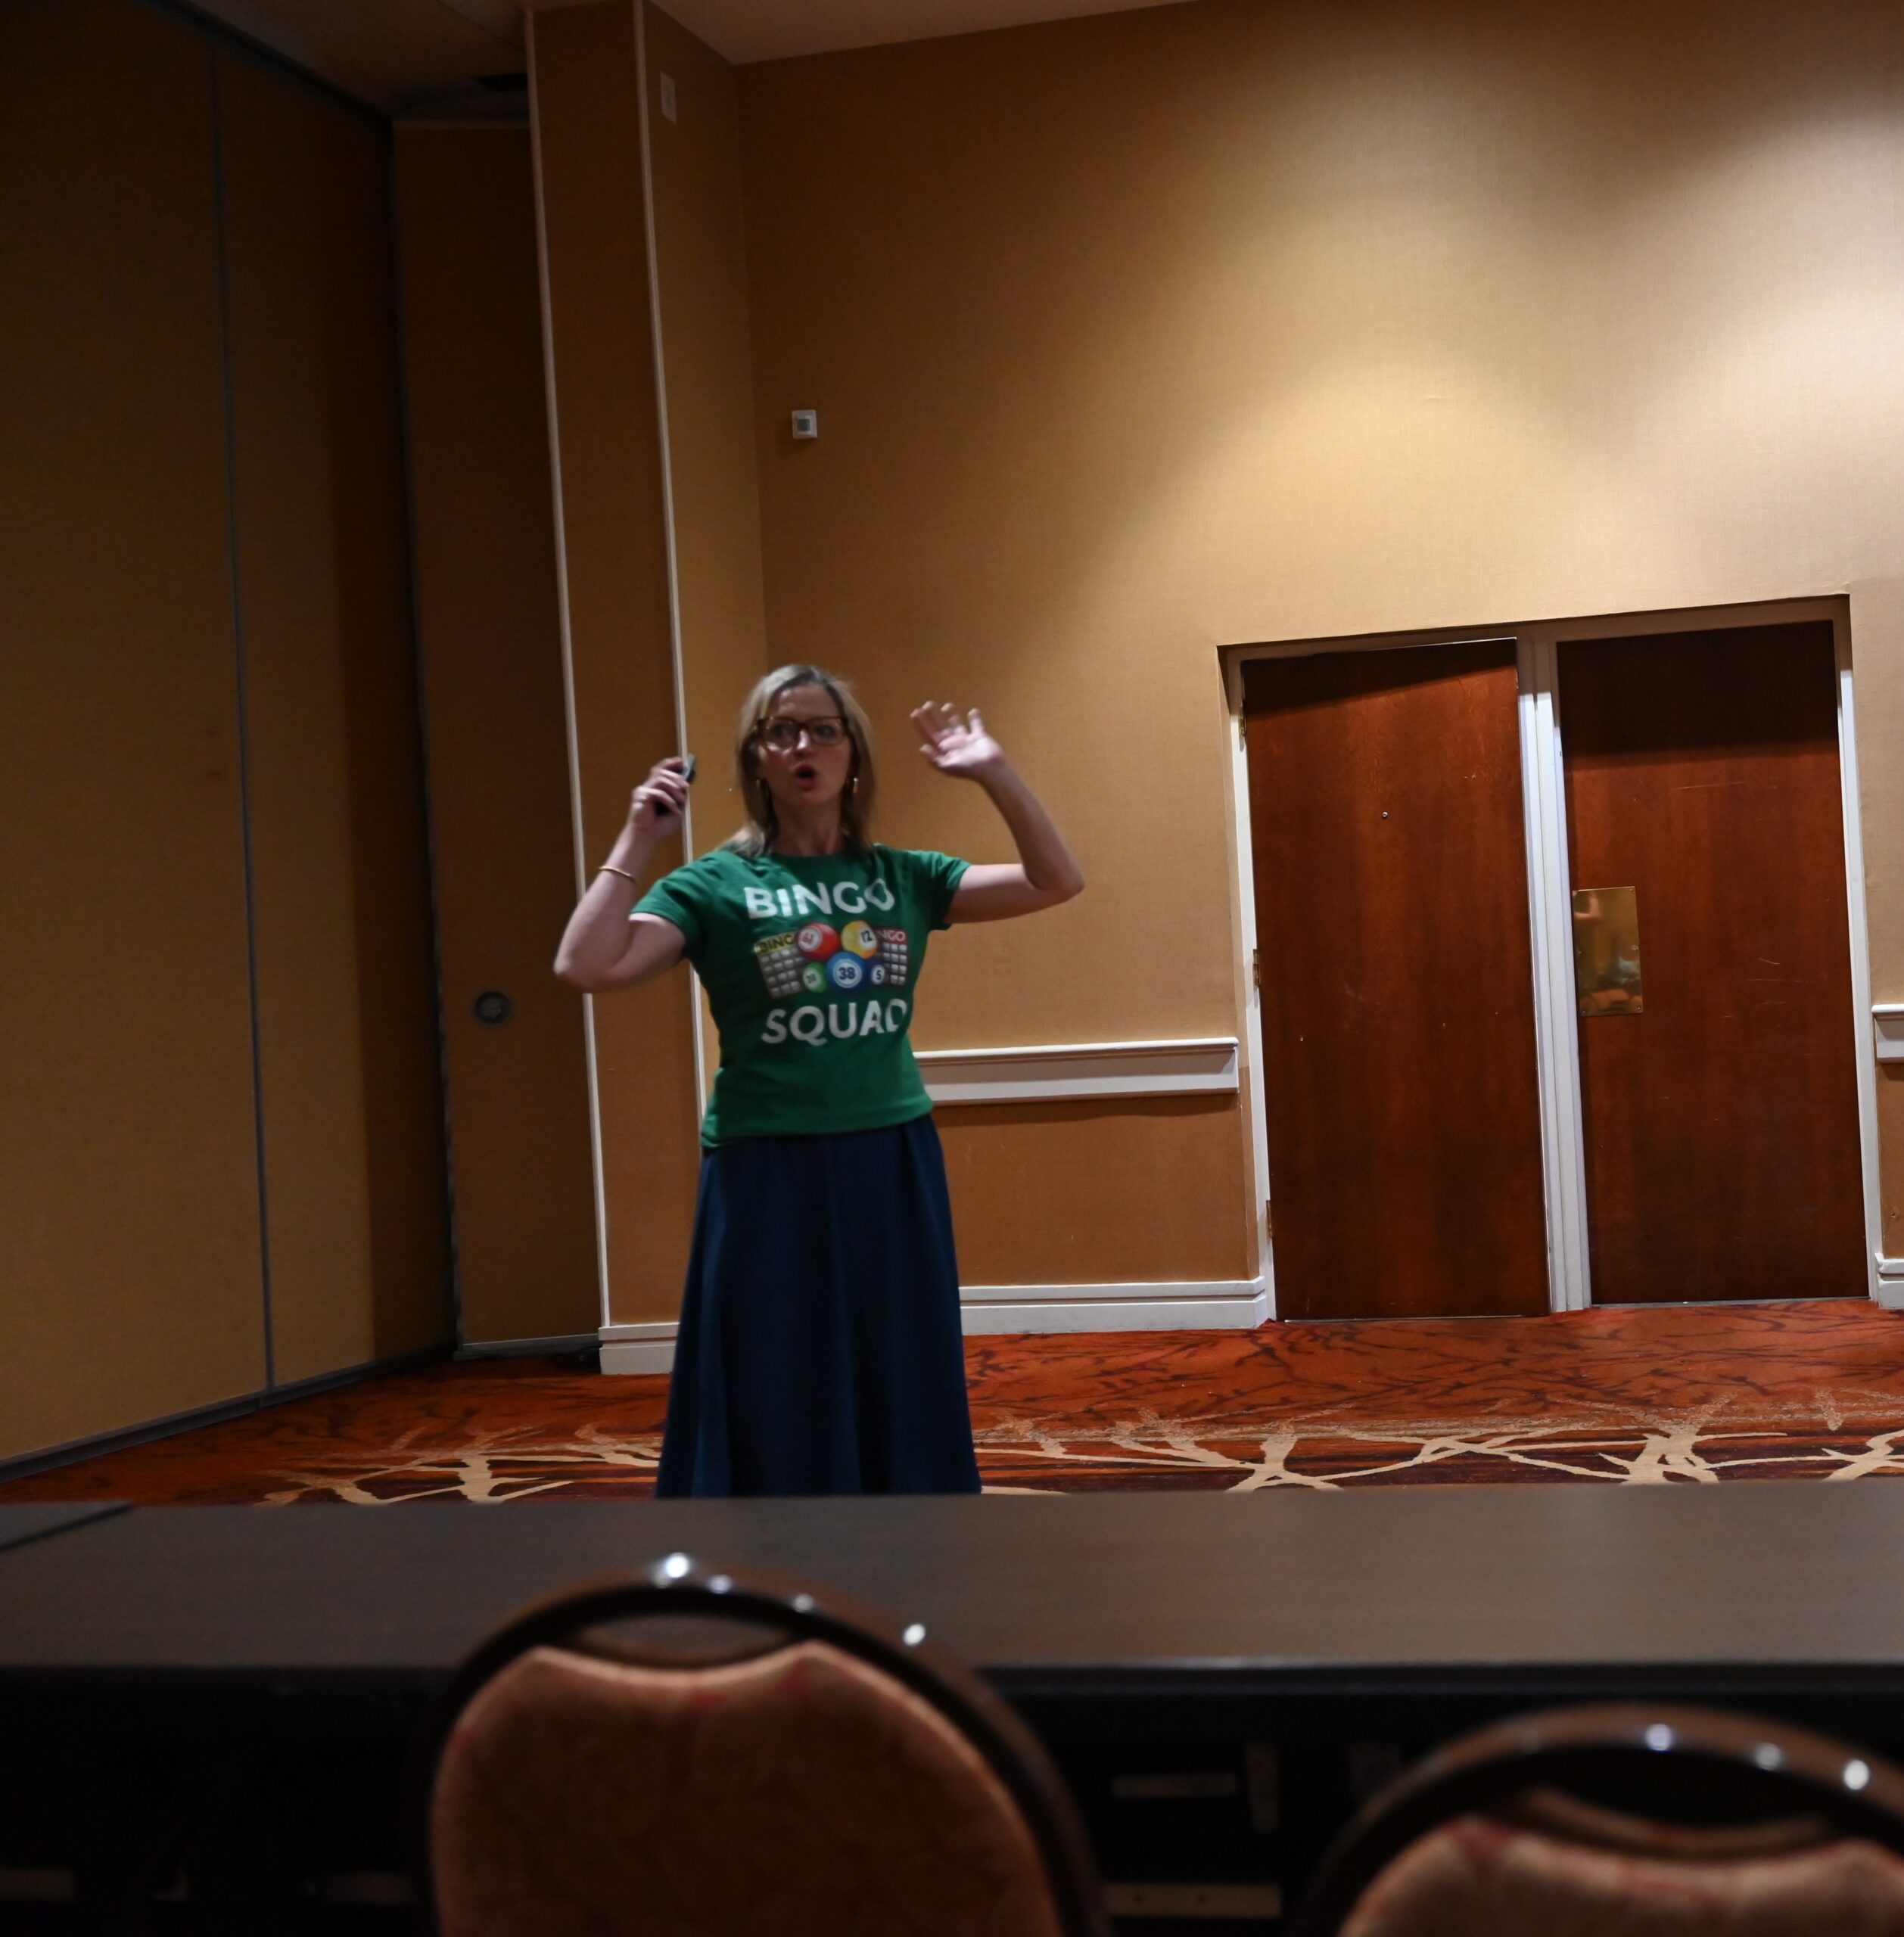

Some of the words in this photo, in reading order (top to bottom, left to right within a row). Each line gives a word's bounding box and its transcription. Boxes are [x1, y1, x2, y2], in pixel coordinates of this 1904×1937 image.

[744, 878, 895, 919] BINGO
[838, 967, 856, 980] 38
[876, 969, 882, 980] 5
[761, 998, 907, 1046] SQUAD
